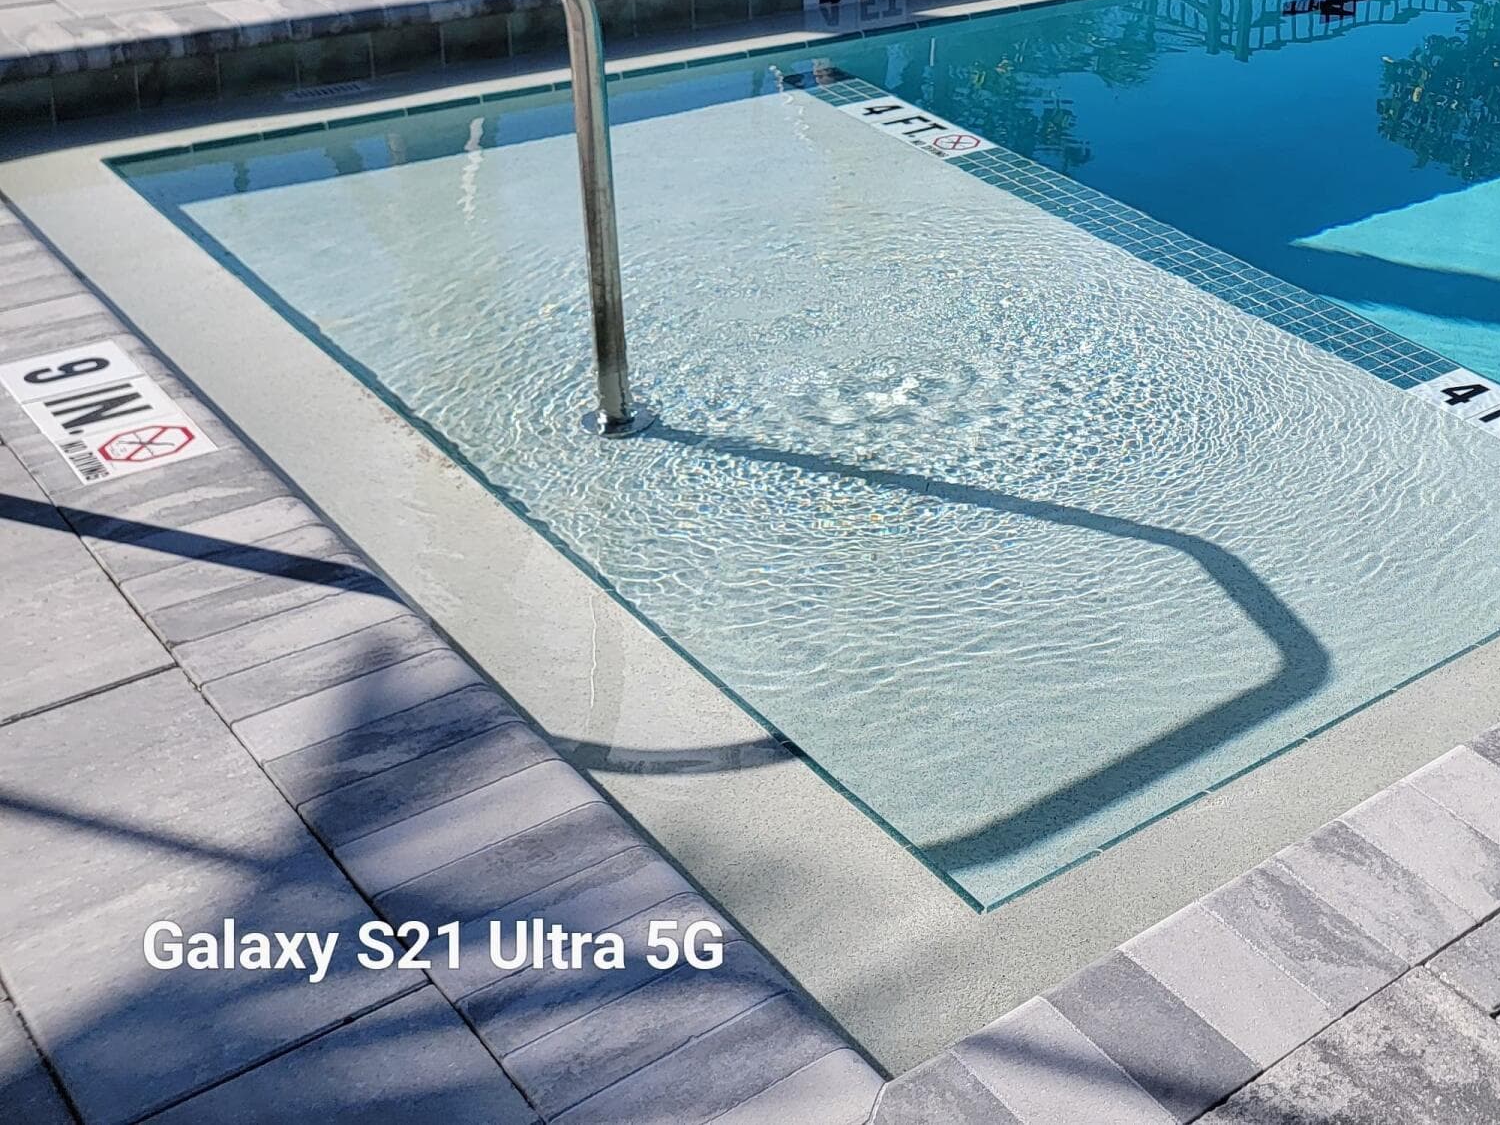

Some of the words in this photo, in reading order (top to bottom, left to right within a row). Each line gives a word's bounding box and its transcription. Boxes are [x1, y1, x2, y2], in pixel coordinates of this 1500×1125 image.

[863, 105, 904, 116] 4
[882, 115, 948, 137] FT.
[23, 357, 110, 384] 9
[1441, 384, 1490, 406] 4
[43, 383, 154, 435] IN.
